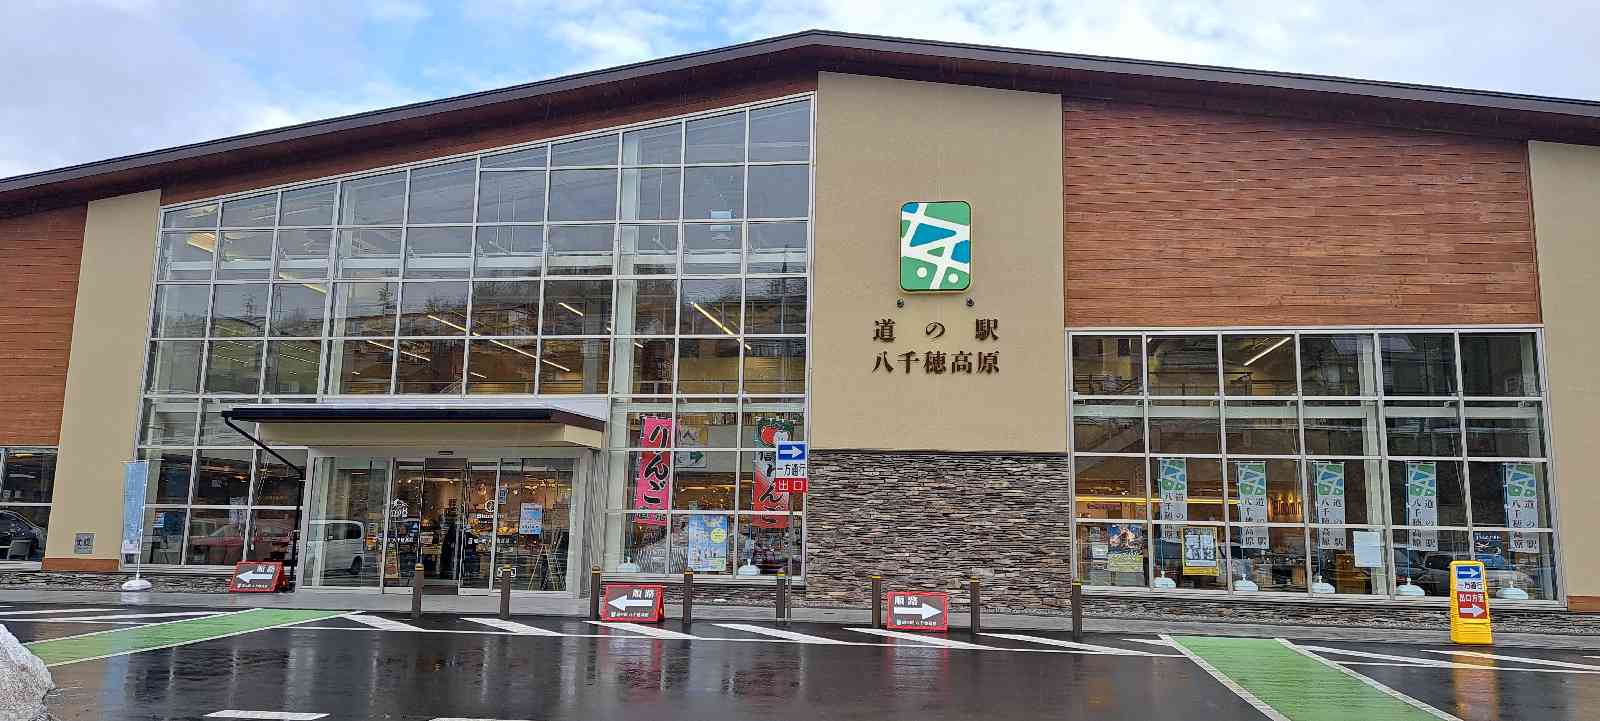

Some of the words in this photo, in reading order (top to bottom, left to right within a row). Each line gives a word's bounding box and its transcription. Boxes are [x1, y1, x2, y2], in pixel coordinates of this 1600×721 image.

[872, 318, 999, 343] 道の駅
[872, 350, 1000, 375] 八千穂高原
[643, 425, 670, 504] りんご
[776, 463, 806, 477] 一方通行
[778, 480, 803, 491] 出口
[894, 595, 918, 606] 順路
